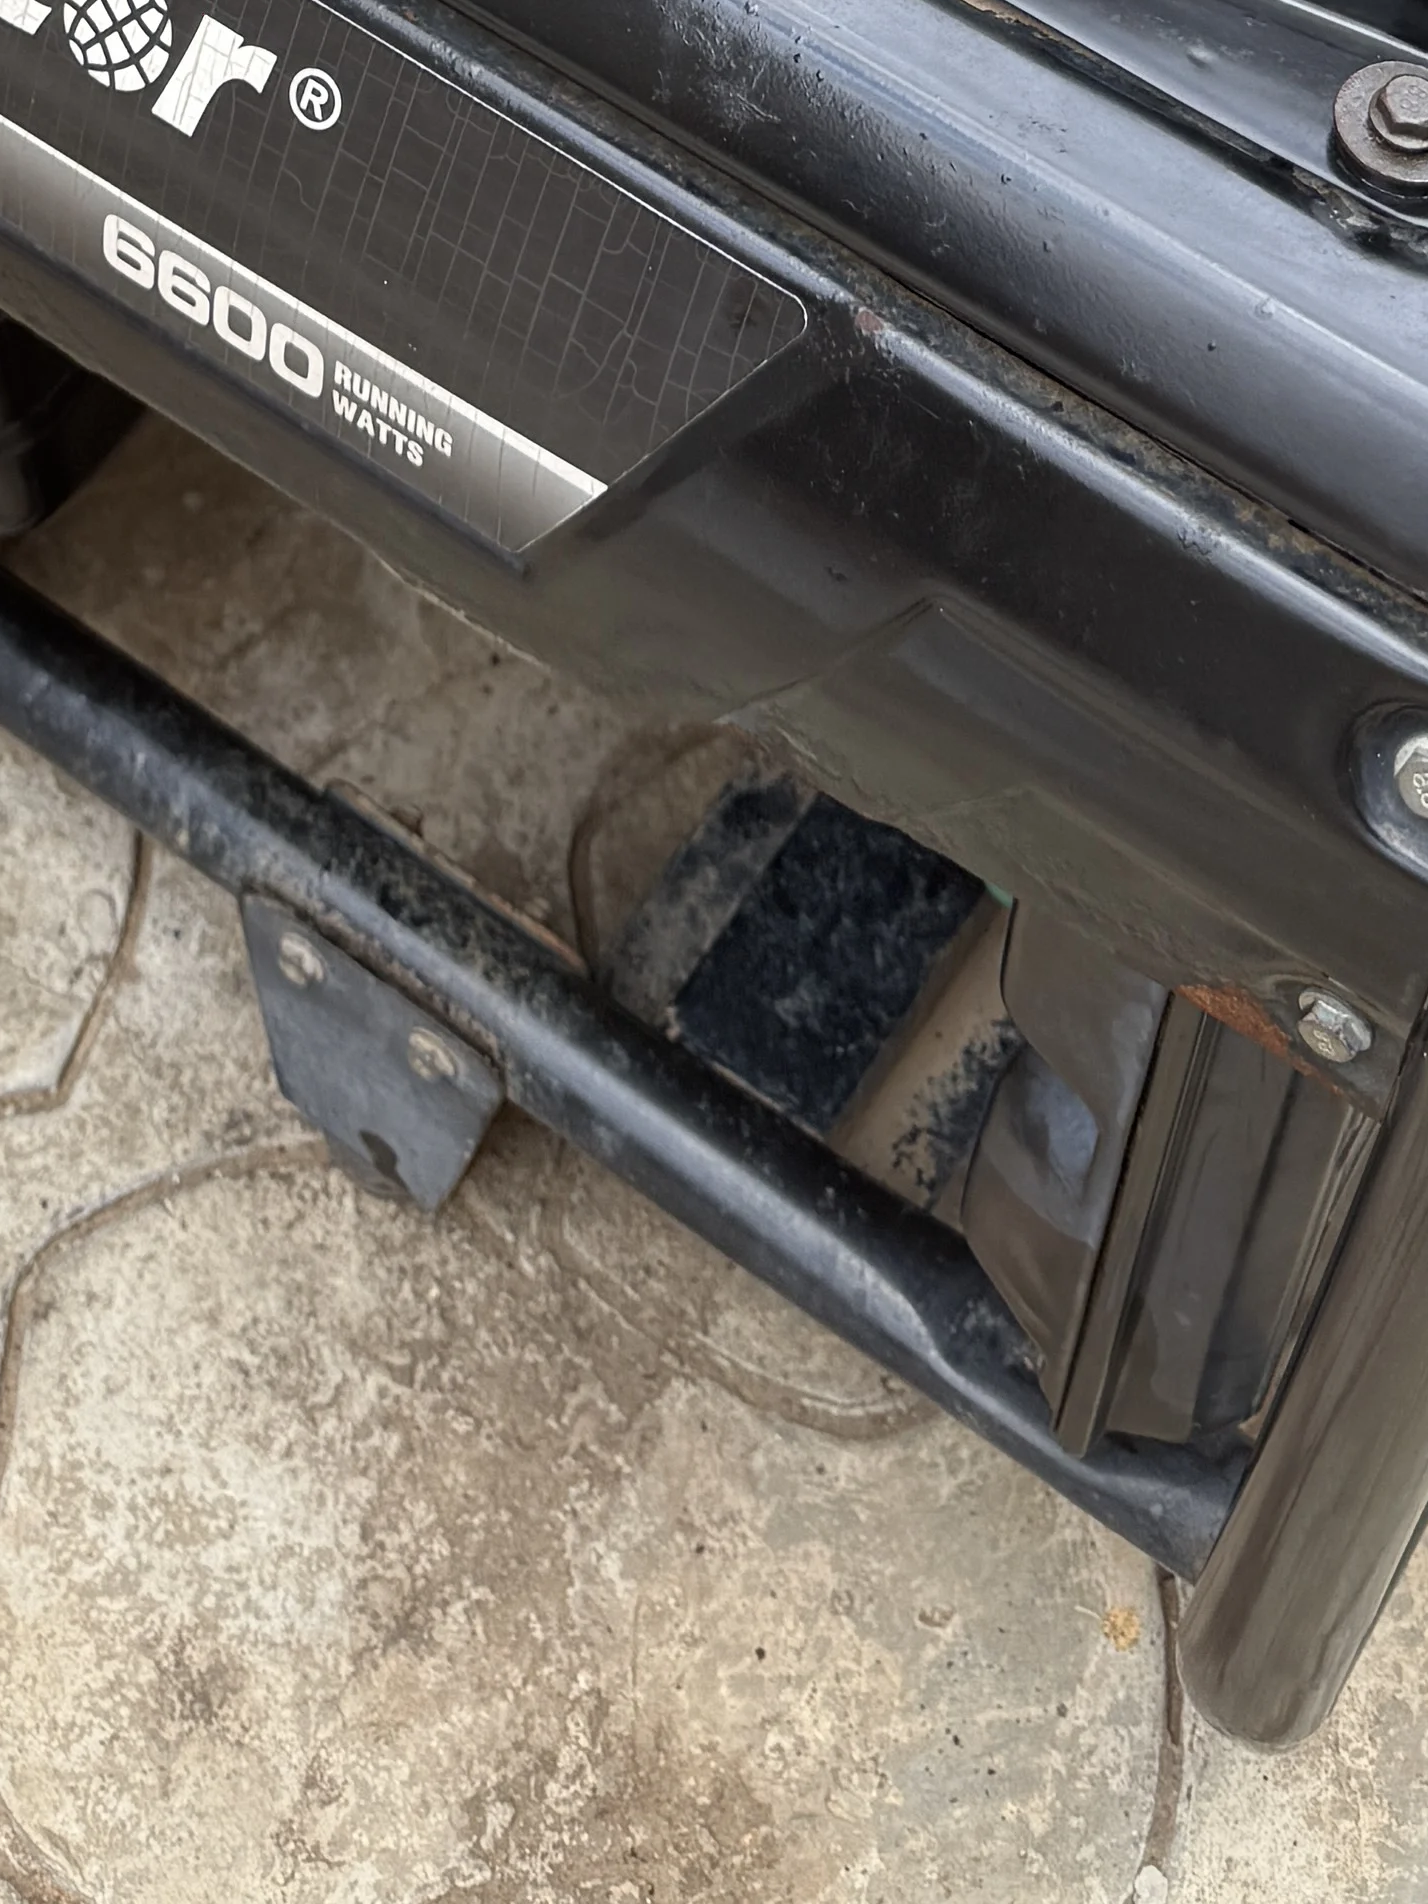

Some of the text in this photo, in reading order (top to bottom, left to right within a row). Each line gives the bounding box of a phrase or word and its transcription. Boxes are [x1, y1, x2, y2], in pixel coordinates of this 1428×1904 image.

[102, 213, 324, 400] 6600
[331, 388, 425, 468] WATTS
[333, 359, 454, 459] RUNNING
